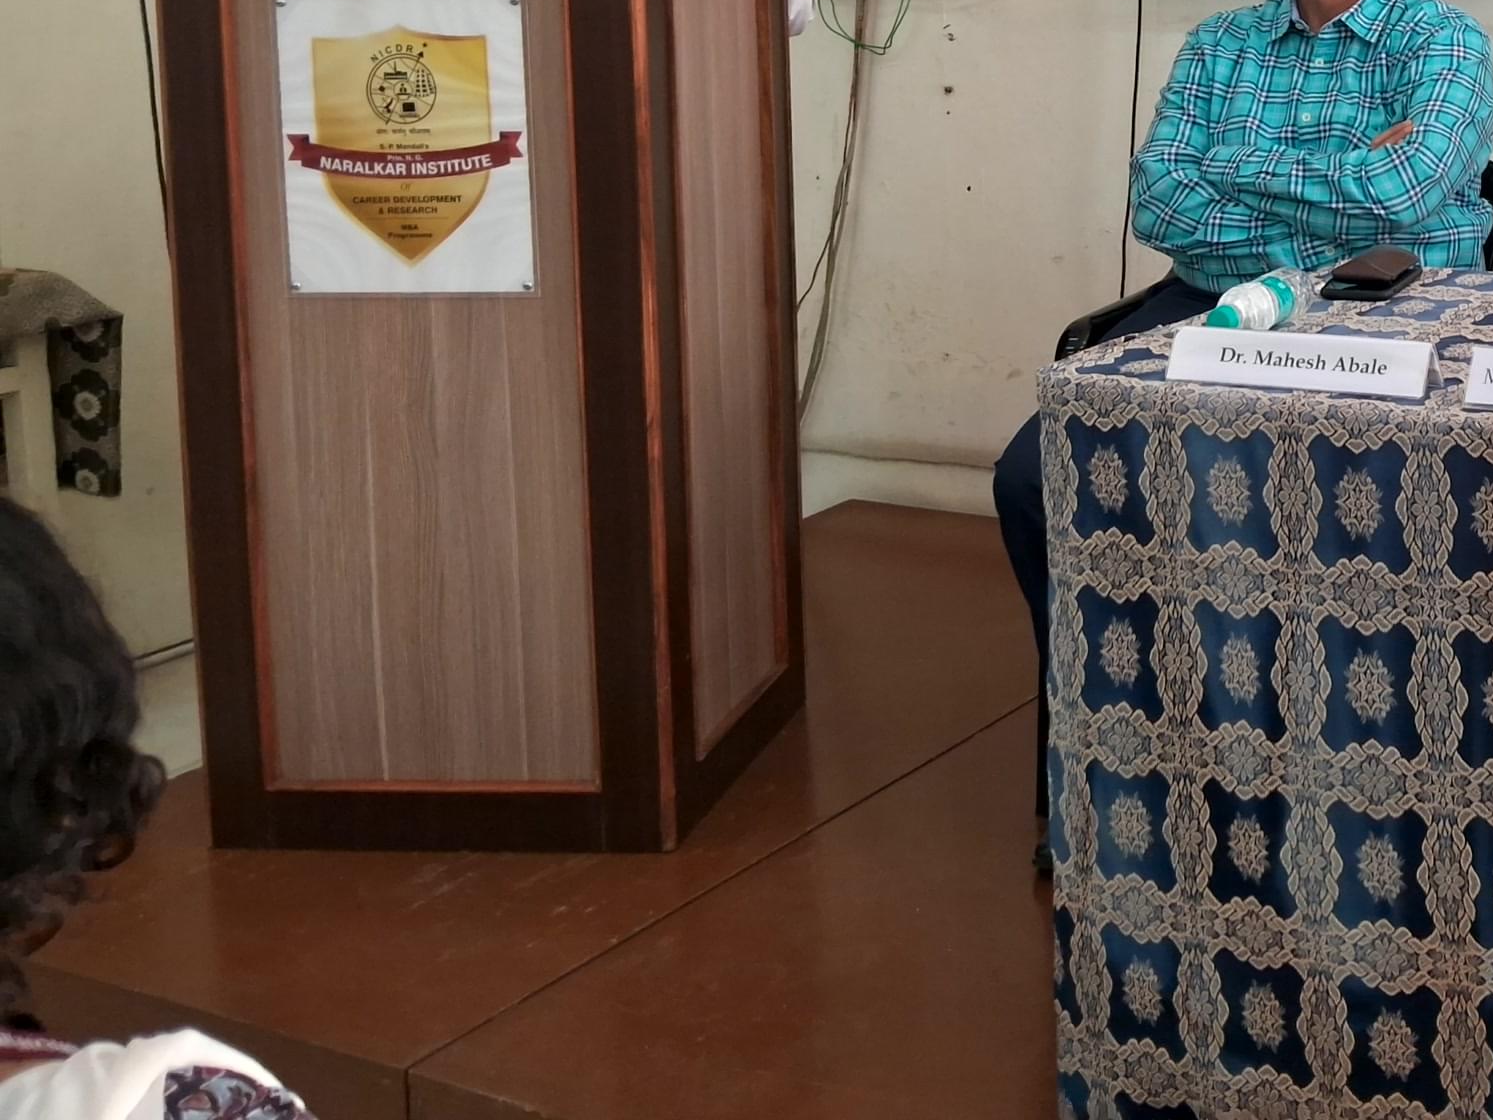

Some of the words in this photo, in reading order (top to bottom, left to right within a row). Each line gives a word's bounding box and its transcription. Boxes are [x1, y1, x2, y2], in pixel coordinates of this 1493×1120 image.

[370, 43, 414, 63] NICDR
[320, 156, 406, 176] NARALKAR
[411, 154, 493, 175] INSTITUTE
[352, 196, 391, 204] CAREER
[393, 194, 462, 203] DEVELOPMENT
[387, 206, 438, 215] RESEARCH
[1219, 346, 1247, 365] Dr.
[1253, 349, 1327, 371] Mahesh
[1332, 355, 1388, 376] Abale
